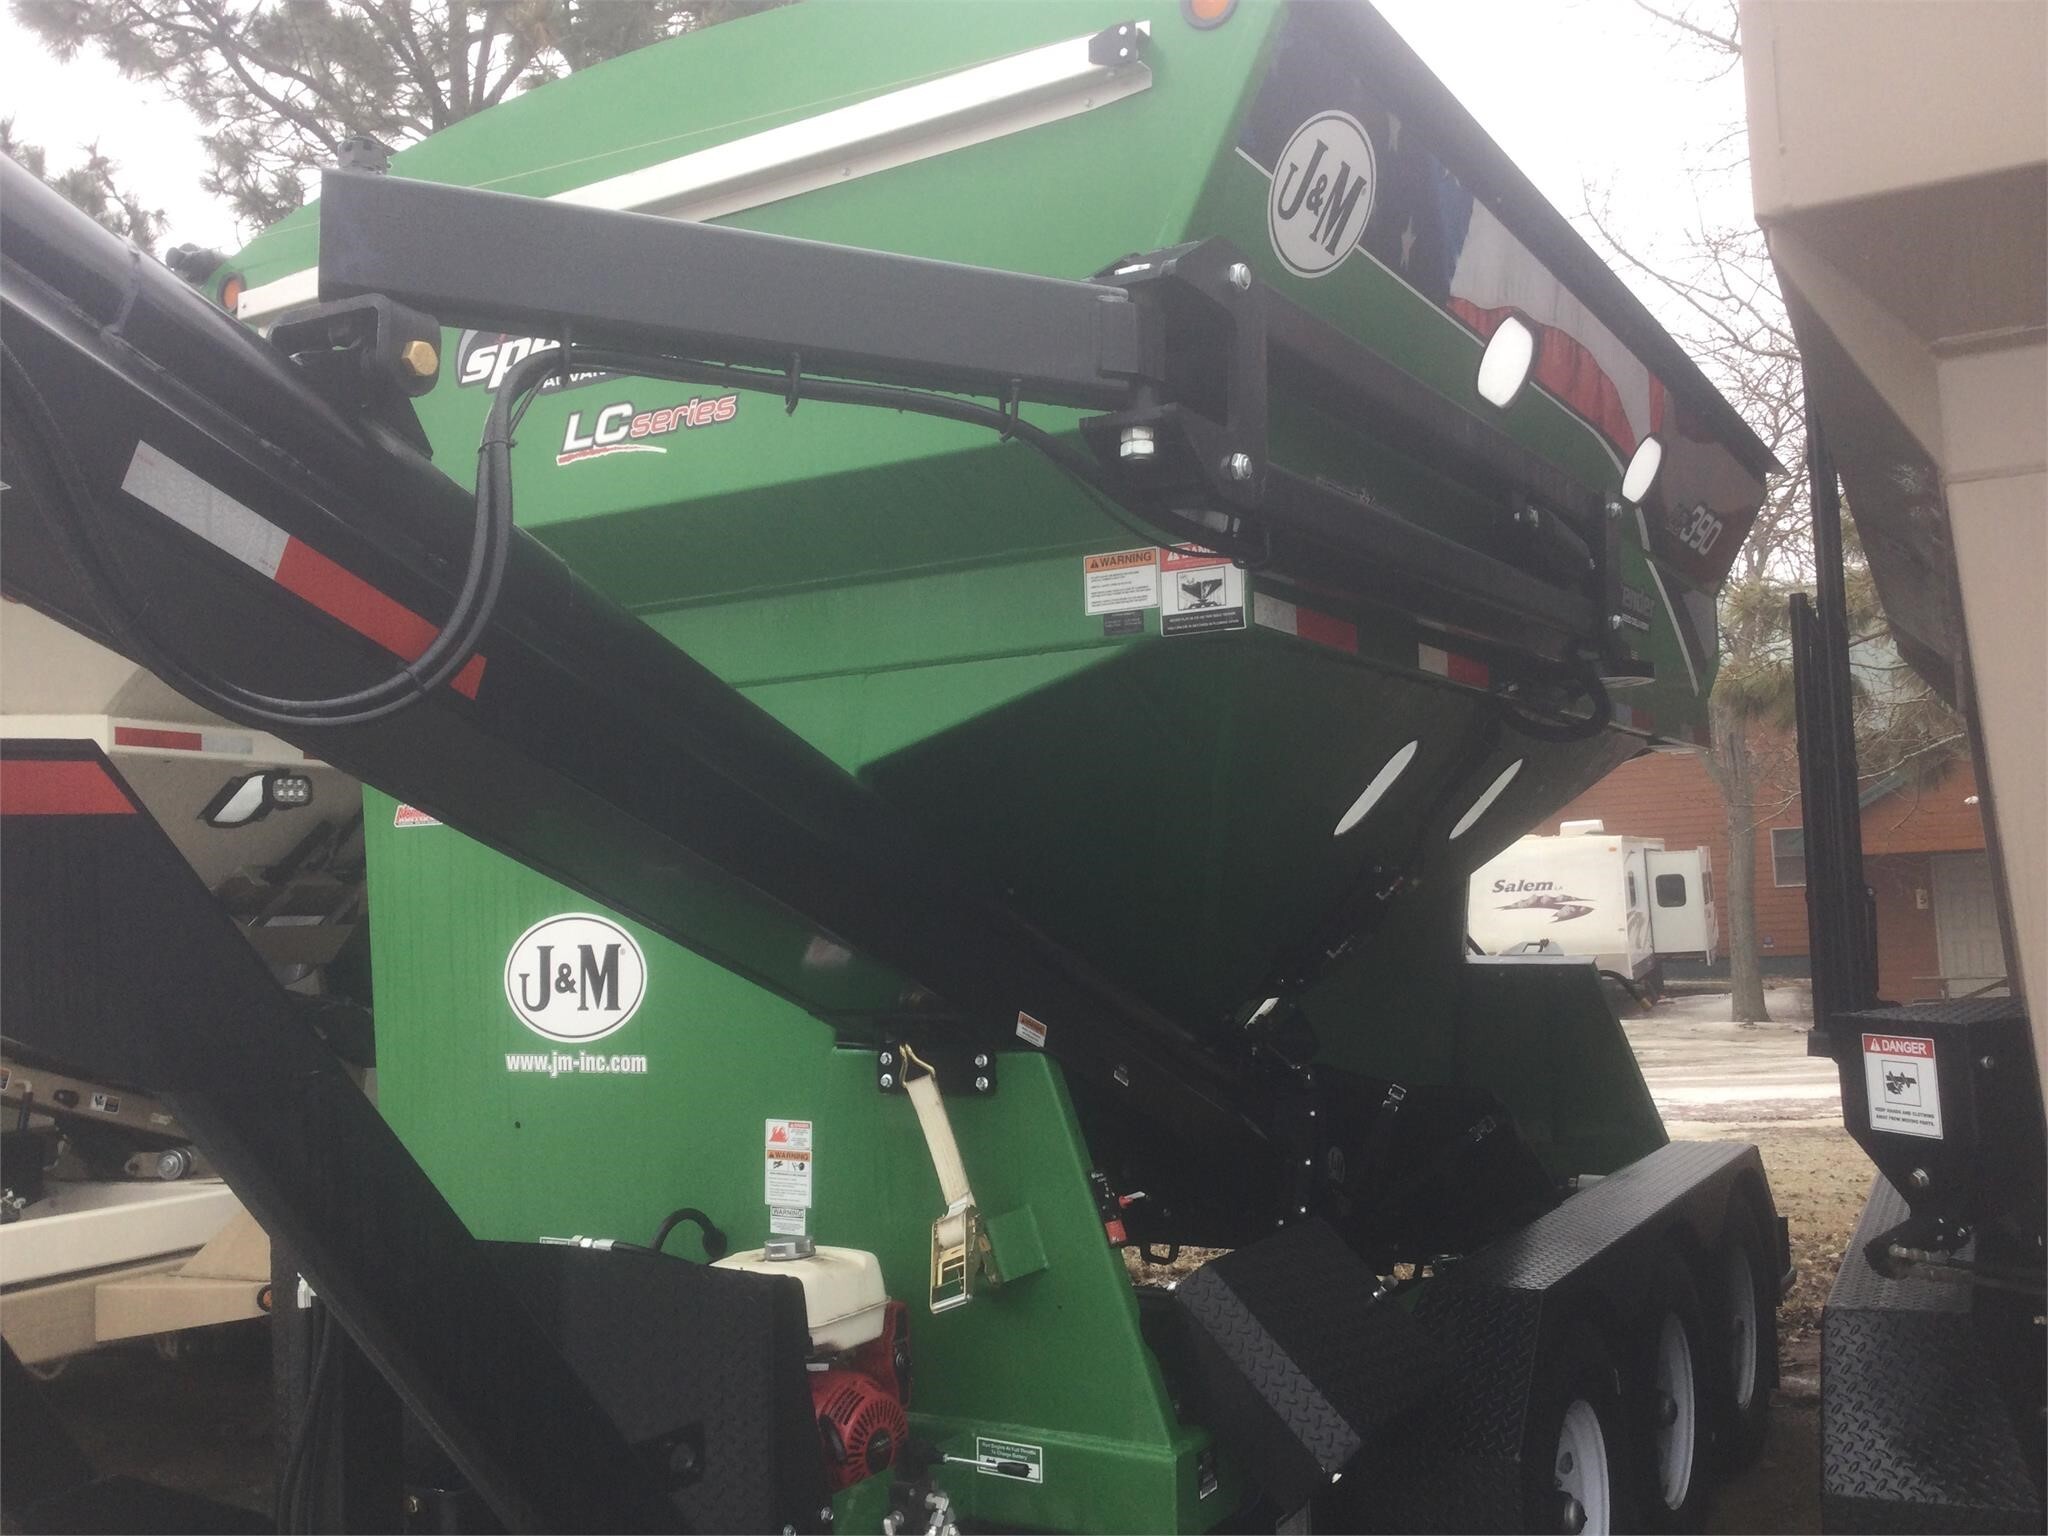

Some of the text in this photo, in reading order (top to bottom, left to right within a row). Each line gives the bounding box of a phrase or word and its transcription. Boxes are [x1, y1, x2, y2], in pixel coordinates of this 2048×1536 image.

[1277, 139, 1368, 256] J&M
[562, 395, 738, 451] LC series
[1679, 504, 1723, 556] 390
[1099, 551, 1152, 568] WARNING
[1492, 879, 1553, 893] Salem
[518, 943, 622, 1012] J&M
[1881, 1039, 1927, 1055] DANGER
[505, 1051, 648, 1078] www.jm-inc.com
[774, 1151, 809, 1161] WARNING
